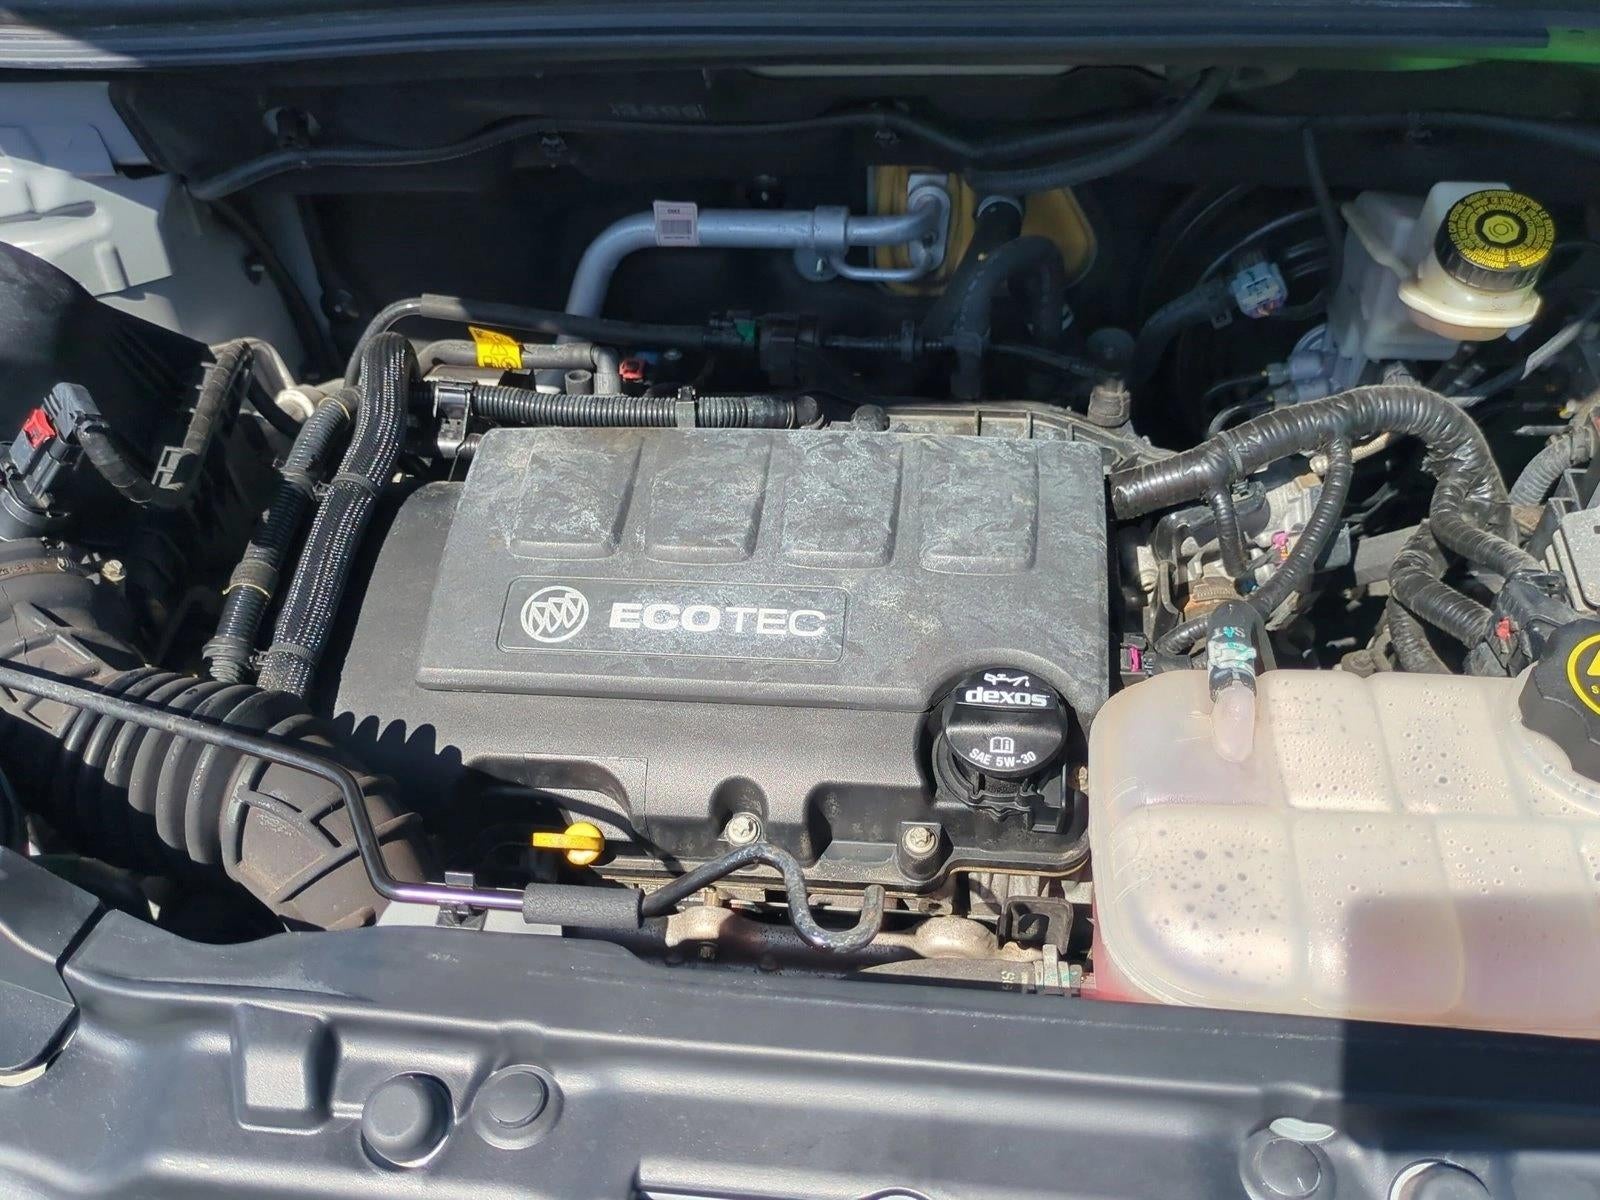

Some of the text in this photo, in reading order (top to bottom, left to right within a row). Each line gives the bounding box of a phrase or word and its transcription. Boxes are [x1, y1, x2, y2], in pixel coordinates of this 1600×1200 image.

[608, 602, 826, 637] ECOTEC
[965, 686, 1048, 707] dexos
[969, 748, 1037, 767] SAE 5W-30
